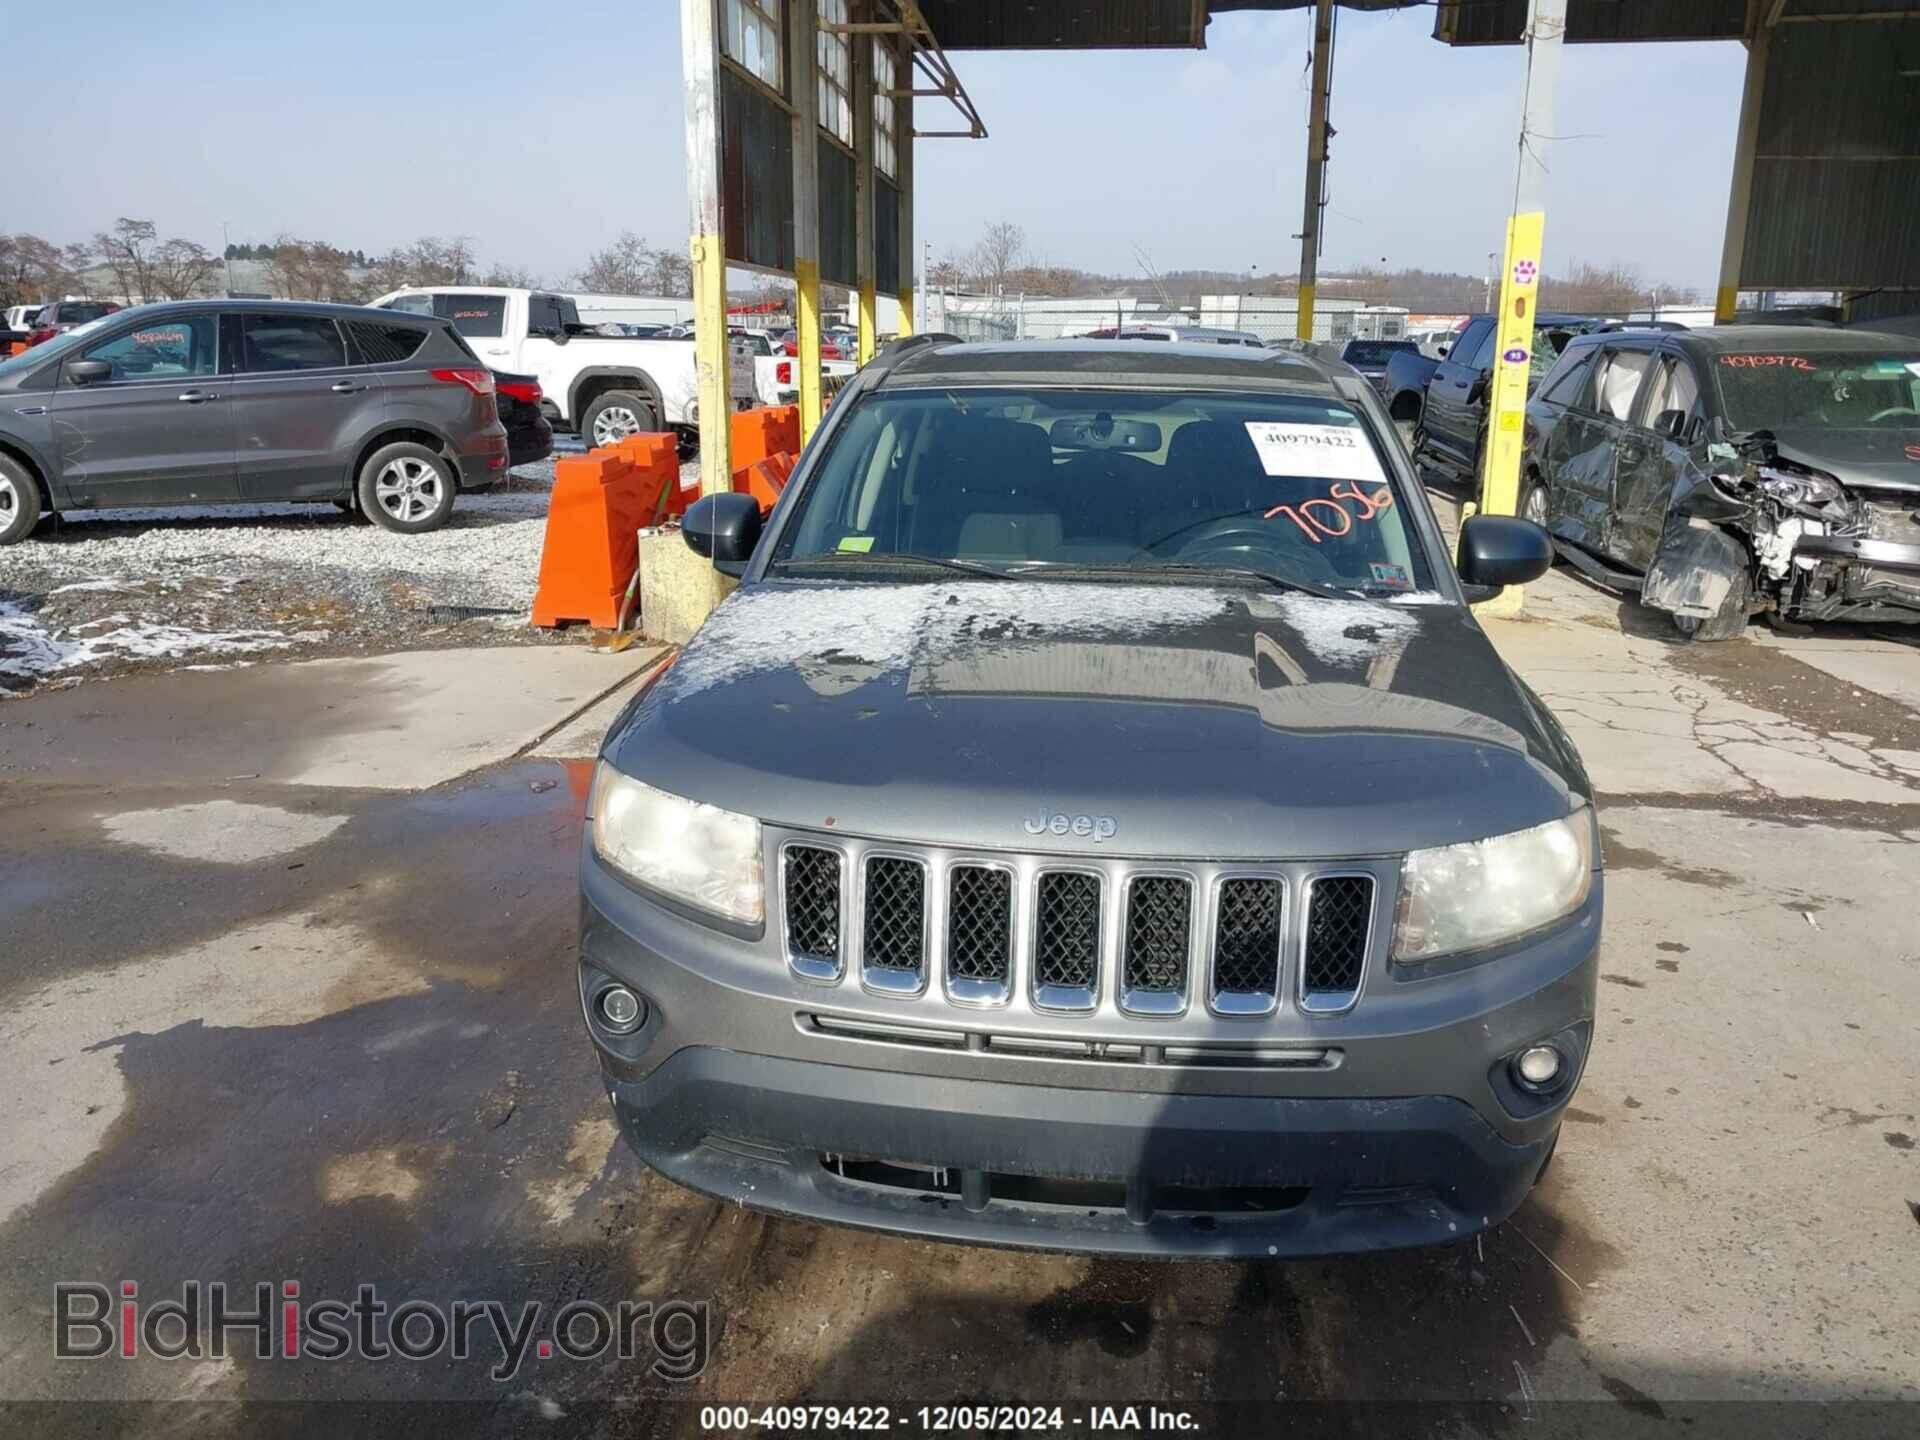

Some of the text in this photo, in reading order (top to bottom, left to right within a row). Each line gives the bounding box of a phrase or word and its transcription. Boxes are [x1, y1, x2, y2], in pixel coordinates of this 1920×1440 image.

[1265, 433, 1357, 448] 40979422
[1264, 480, 1393, 543] 7056
[1024, 811, 1117, 843] Jeep
